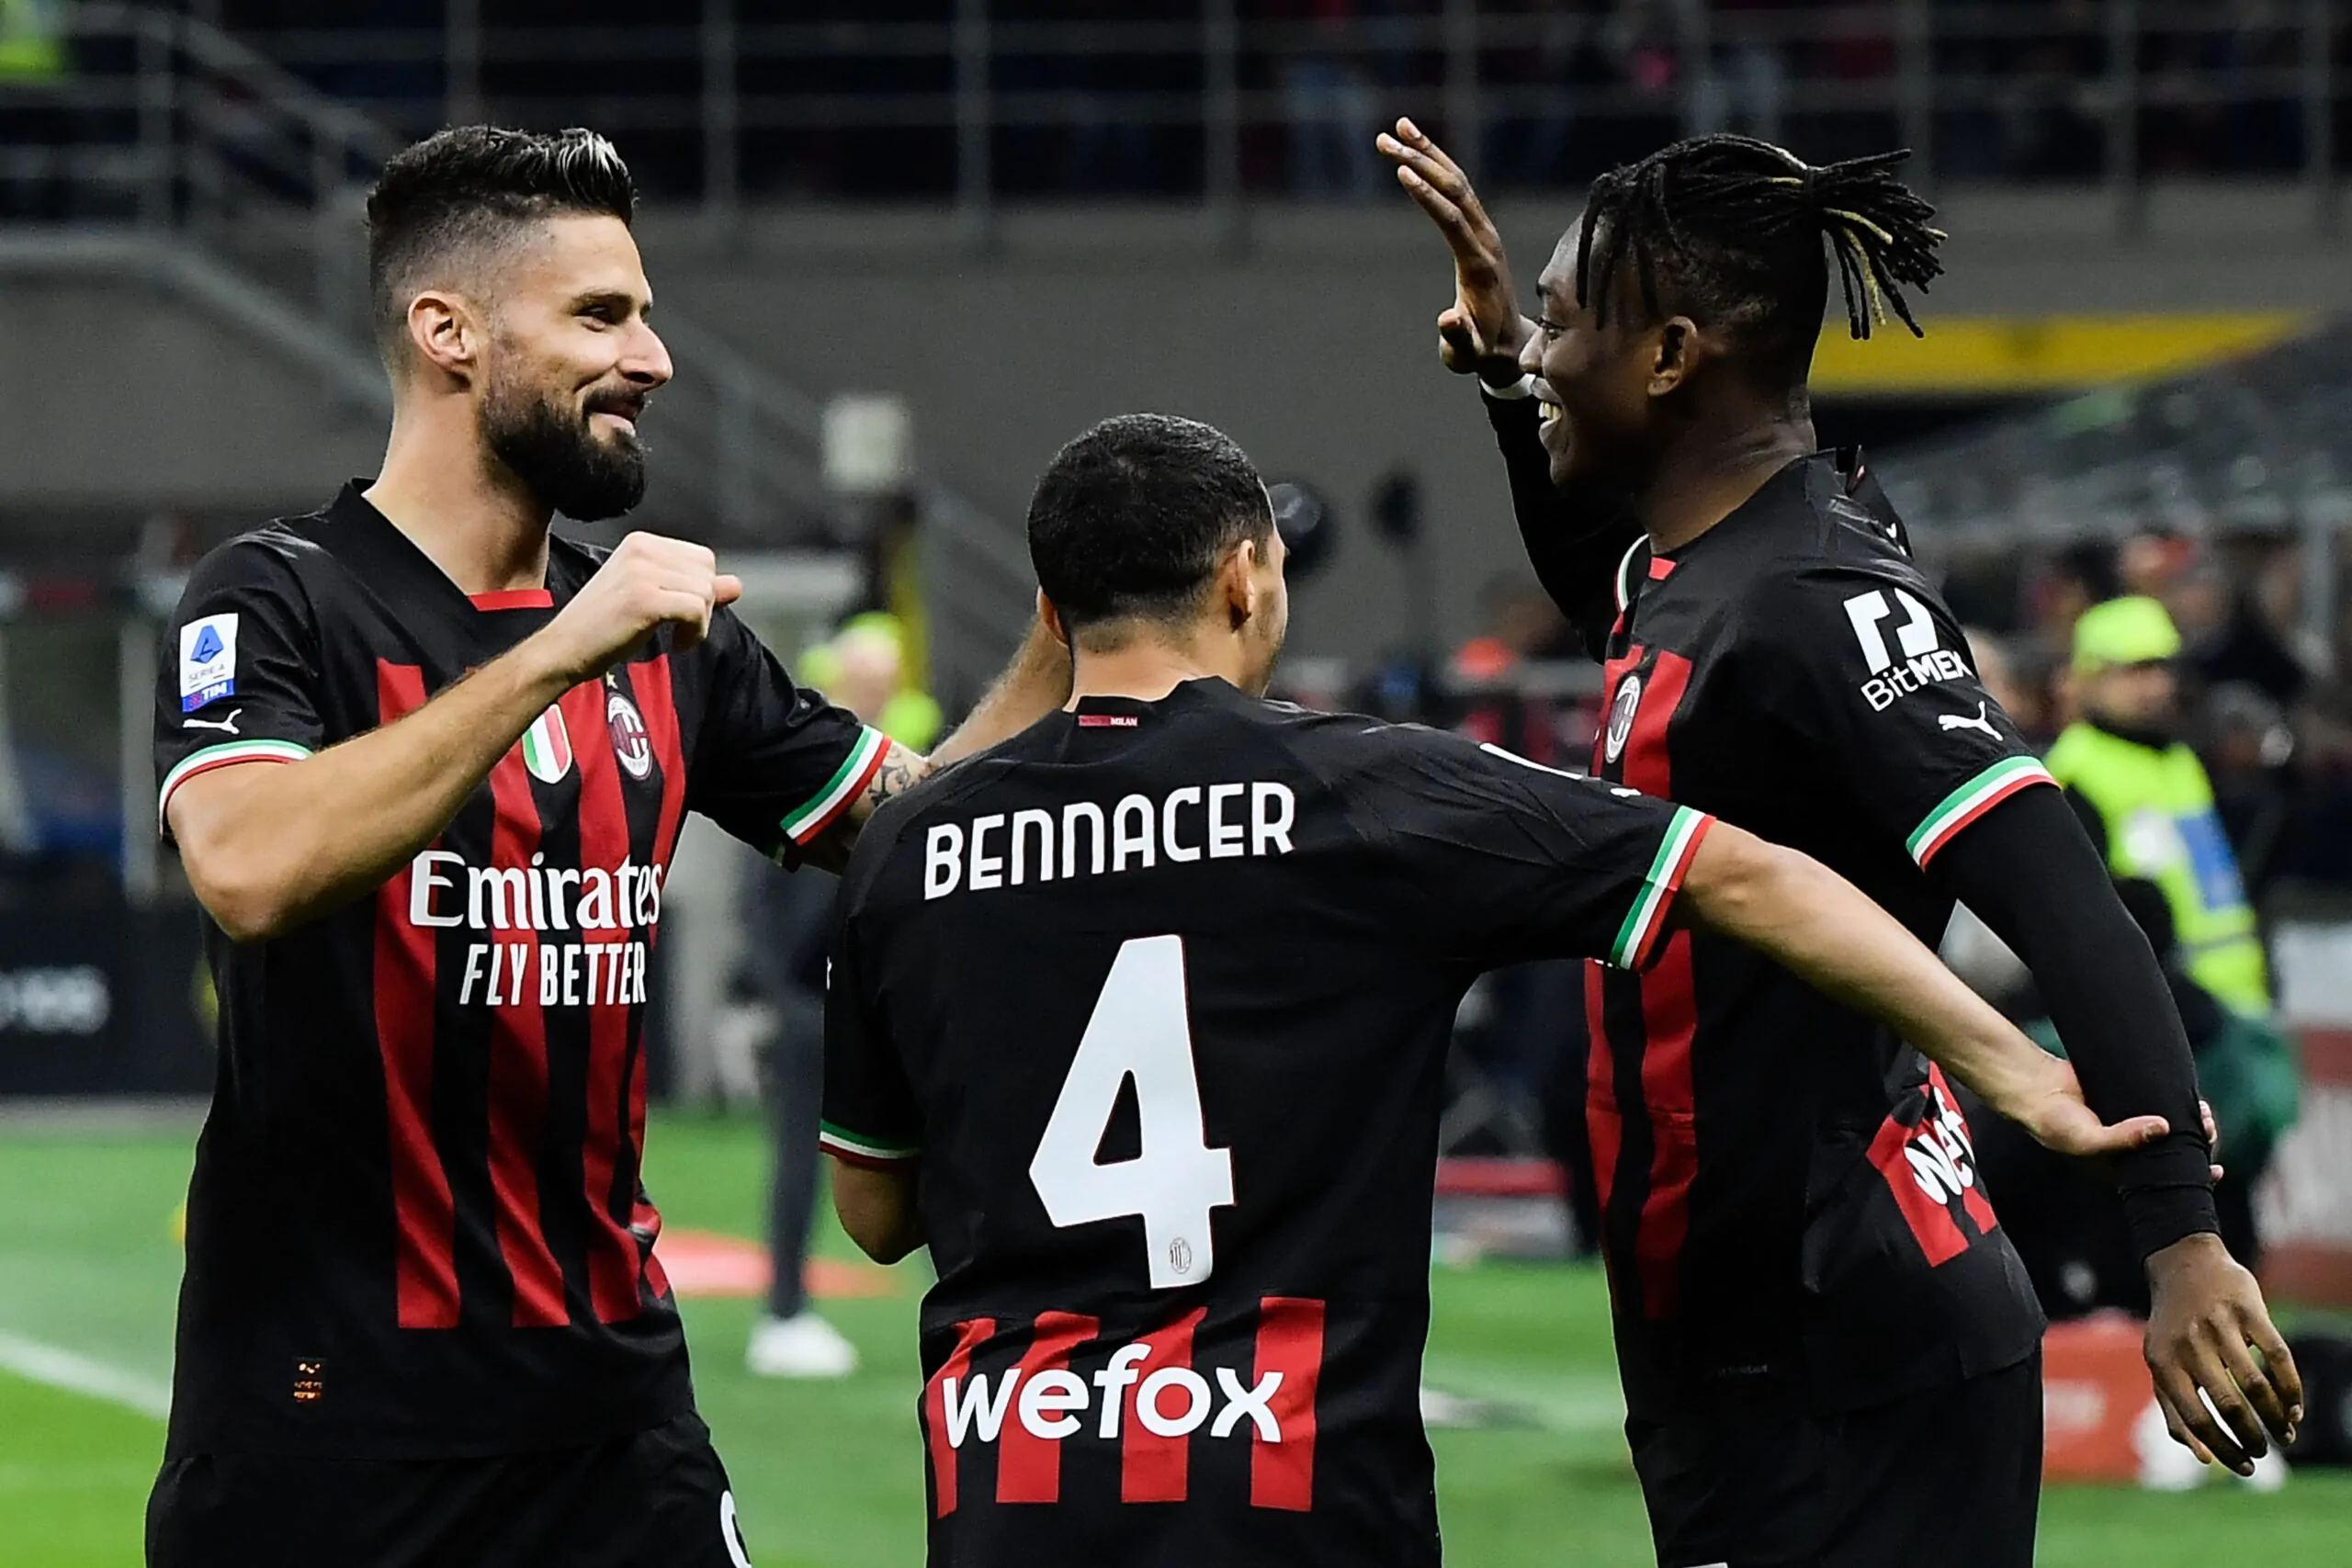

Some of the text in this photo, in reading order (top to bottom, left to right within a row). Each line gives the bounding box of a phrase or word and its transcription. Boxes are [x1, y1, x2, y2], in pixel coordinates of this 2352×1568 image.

[189, 666, 214, 682] SERIE
[202, 682, 228, 701] TIM
[1110, 716, 1138, 727] MILAN
[924, 781, 1296, 901] BENNACER
[410, 850, 662, 931] Emirates
[459, 941, 647, 1006] FLY BETTER
[1028, 933, 1236, 1290] 4
[942, 1341, 1284, 1450] wefox
